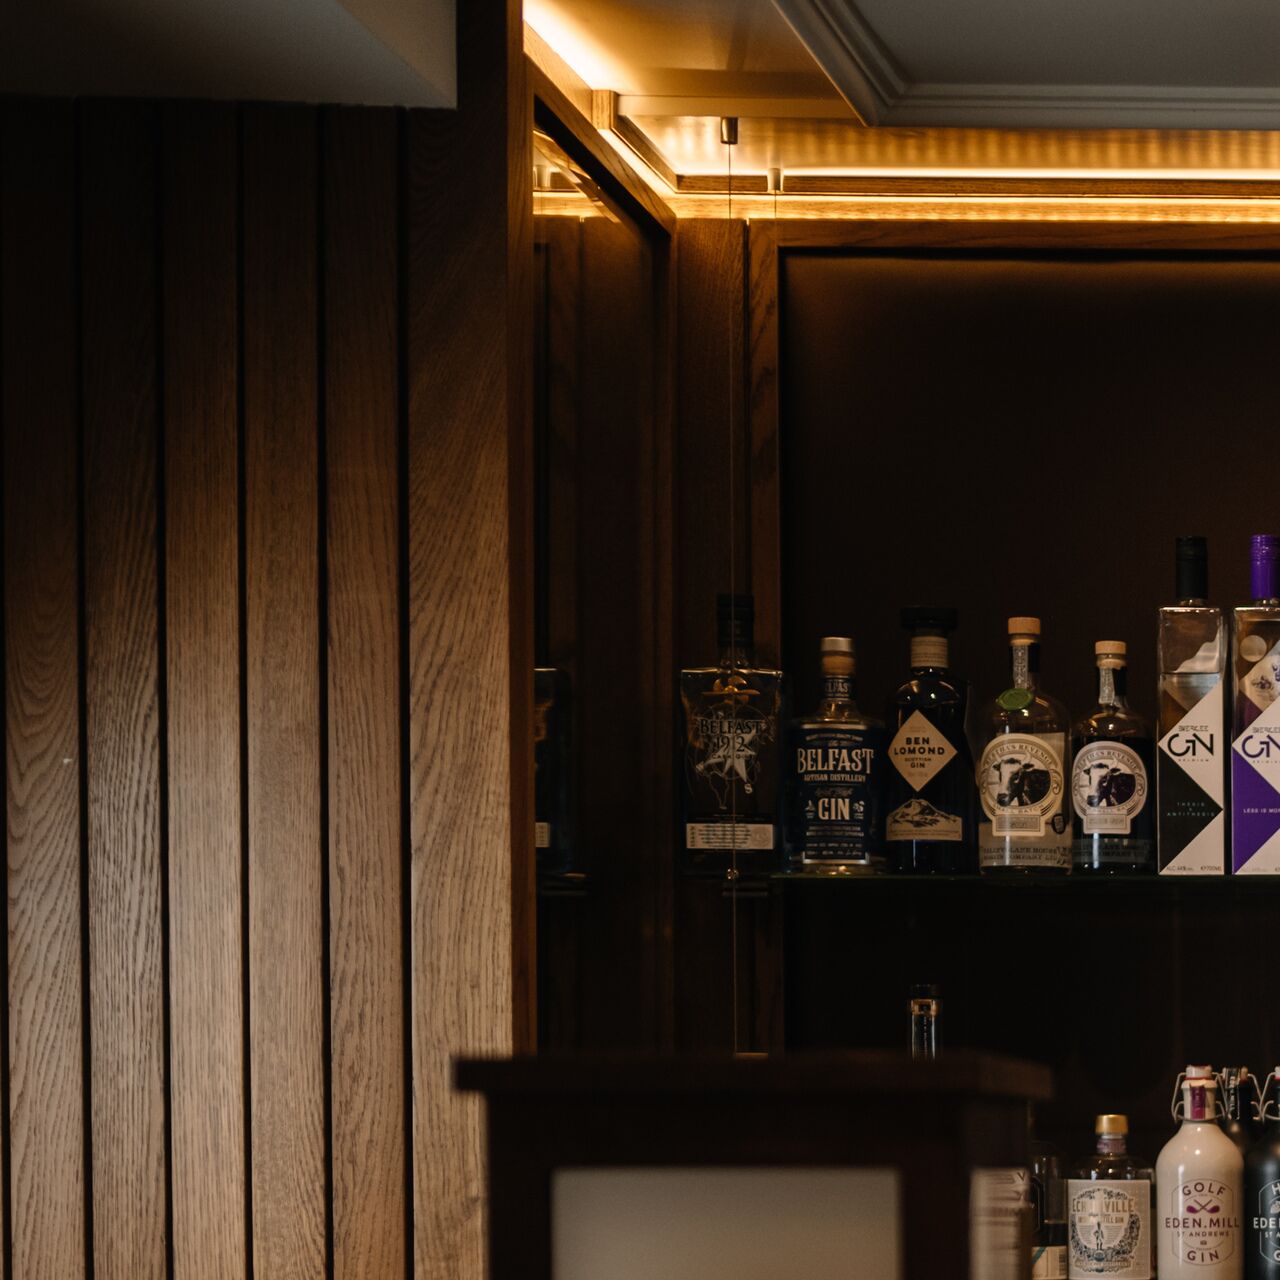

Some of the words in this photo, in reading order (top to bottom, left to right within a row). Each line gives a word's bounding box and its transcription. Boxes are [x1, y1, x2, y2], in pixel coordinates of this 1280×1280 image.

[700, 719, 762, 736] BELFAST
[716, 735, 746, 754] 192
[906, 737, 930, 746] BEN
[894, 747, 945, 756] LOMOND
[797, 748, 874, 774] BELFAST
[818, 798, 850, 821] GIN
[1182, 1182, 1227, 1197] GOLF
[1165, 1217, 1240, 1229] EDEN.MILL
[1187, 1249, 1220, 1262] GIN
